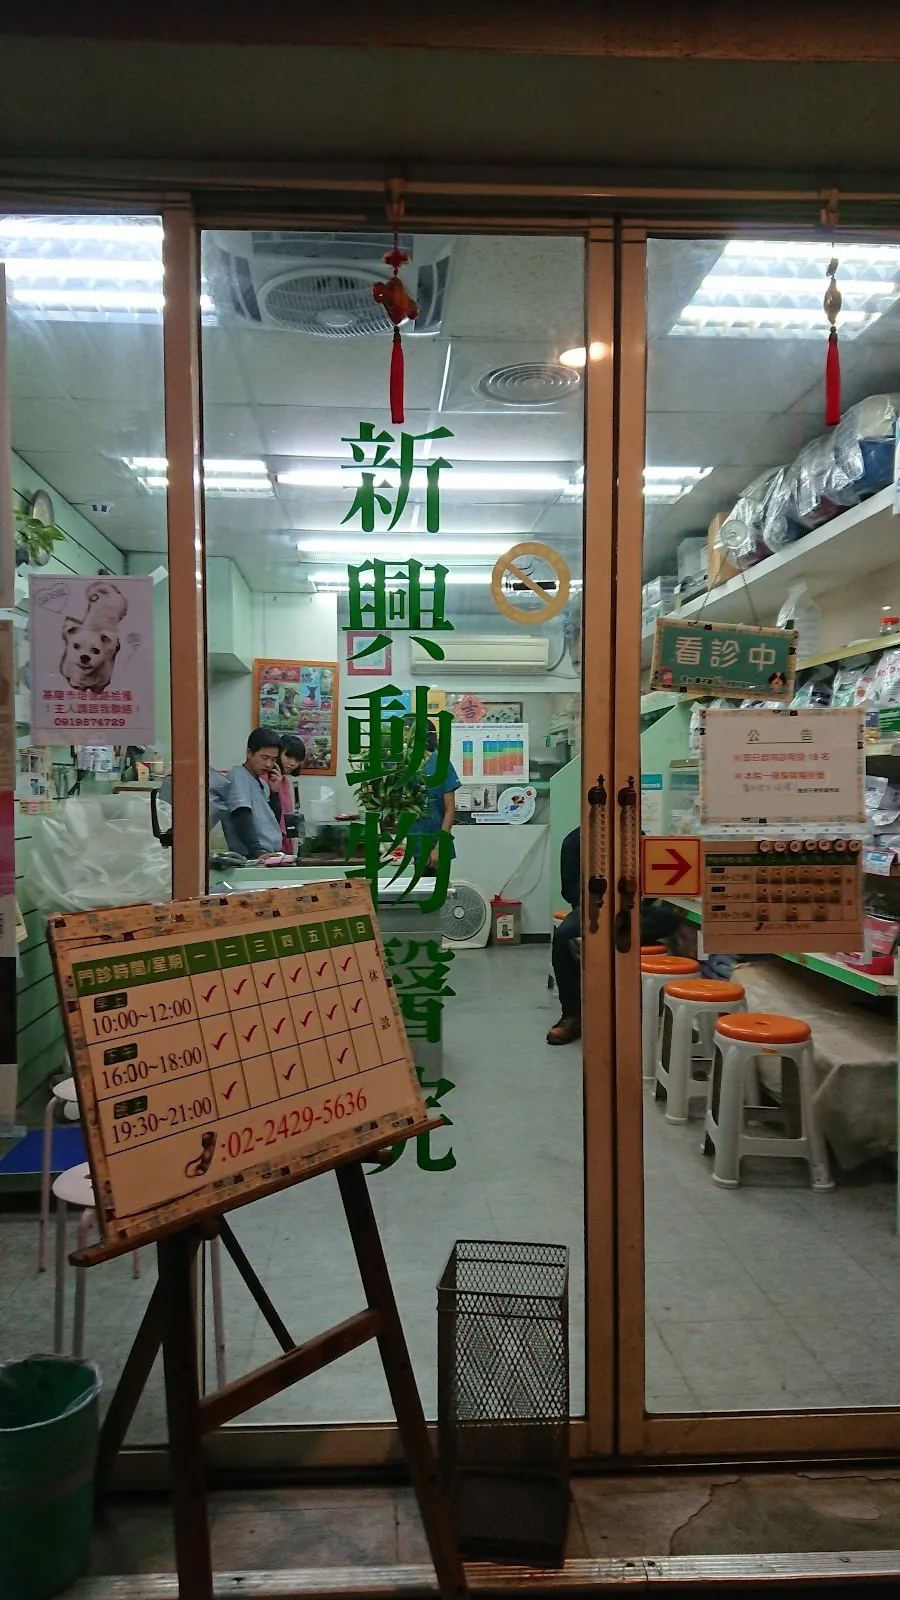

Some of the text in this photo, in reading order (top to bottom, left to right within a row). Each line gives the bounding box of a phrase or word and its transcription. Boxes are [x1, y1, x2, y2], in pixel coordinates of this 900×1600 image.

[675, 636, 776, 671] 看診中
[461, 700, 479, 719] 吉
[747, 728, 814, 742] 公告
[78, 953, 184, 988] 門診時間/星期
[225, 944, 238, 958] 二
[254, 938, 267, 953] 三
[281, 934, 294, 948] 四
[307, 929, 320, 943] 五
[332, 926, 344, 939] 六
[356, 921, 366, 934] 日
[92, 998, 192, 1036] 10:00~12:00
[102, 1046, 202, 1090] 16:00~18:00
[112, 1097, 212, 1144] 19:30~21:00
